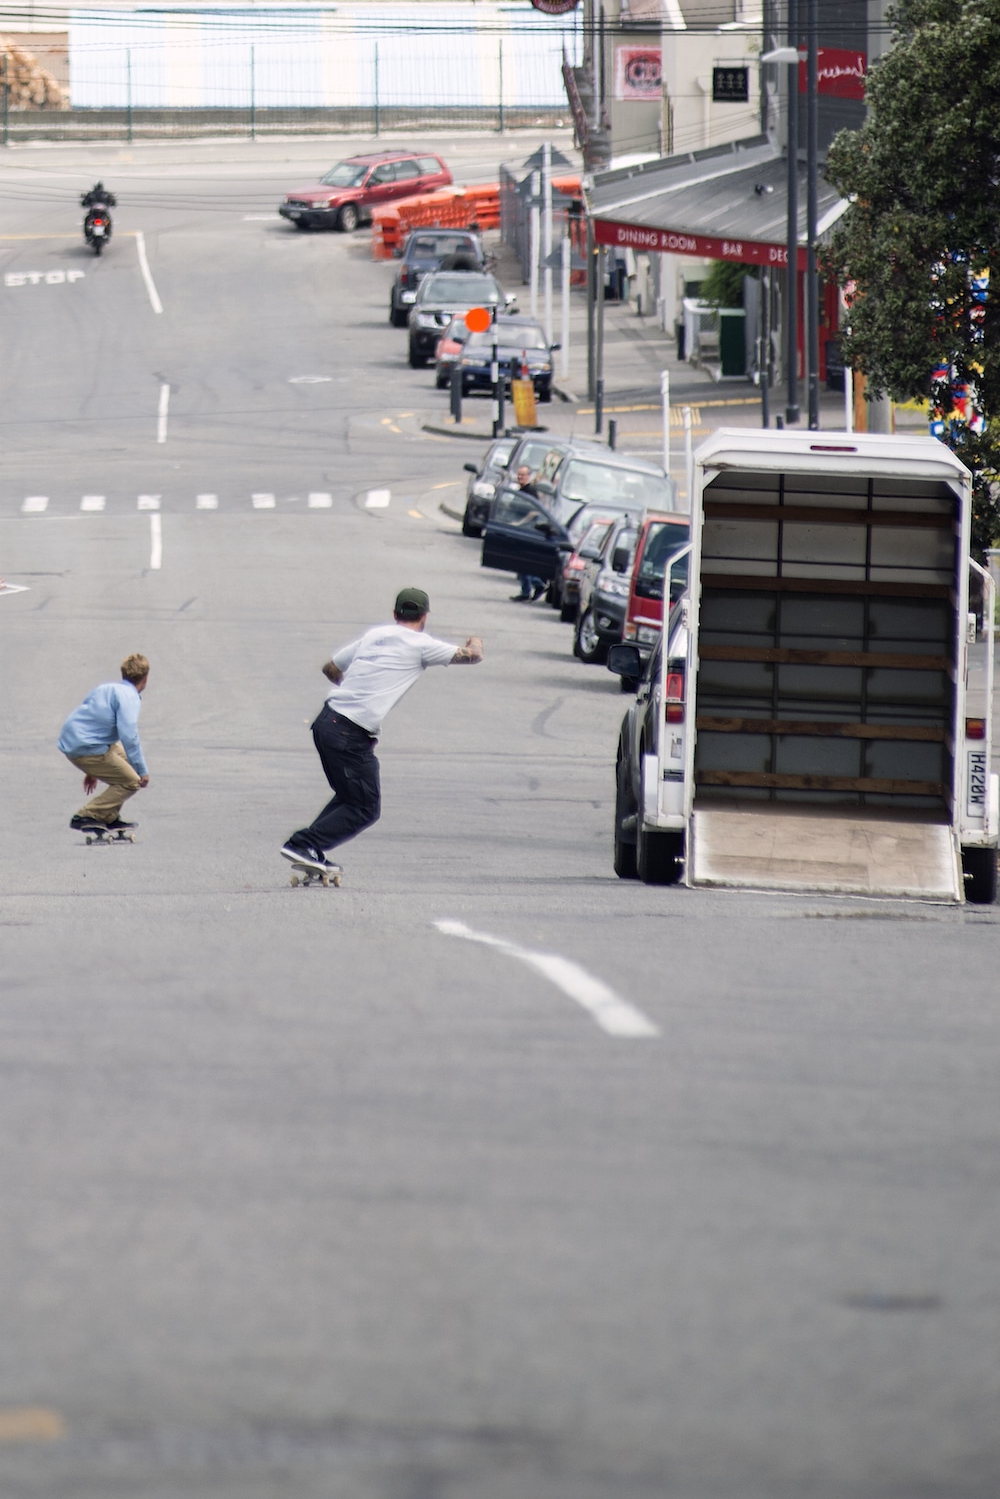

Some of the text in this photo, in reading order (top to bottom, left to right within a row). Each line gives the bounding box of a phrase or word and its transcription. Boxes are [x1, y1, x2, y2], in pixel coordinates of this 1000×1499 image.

[617, 228, 658, 246] DINING
[661, 232, 697, 251] ROOM
[722, 241, 743, 257] BAR
[4, 269, 86, 287] STOP
